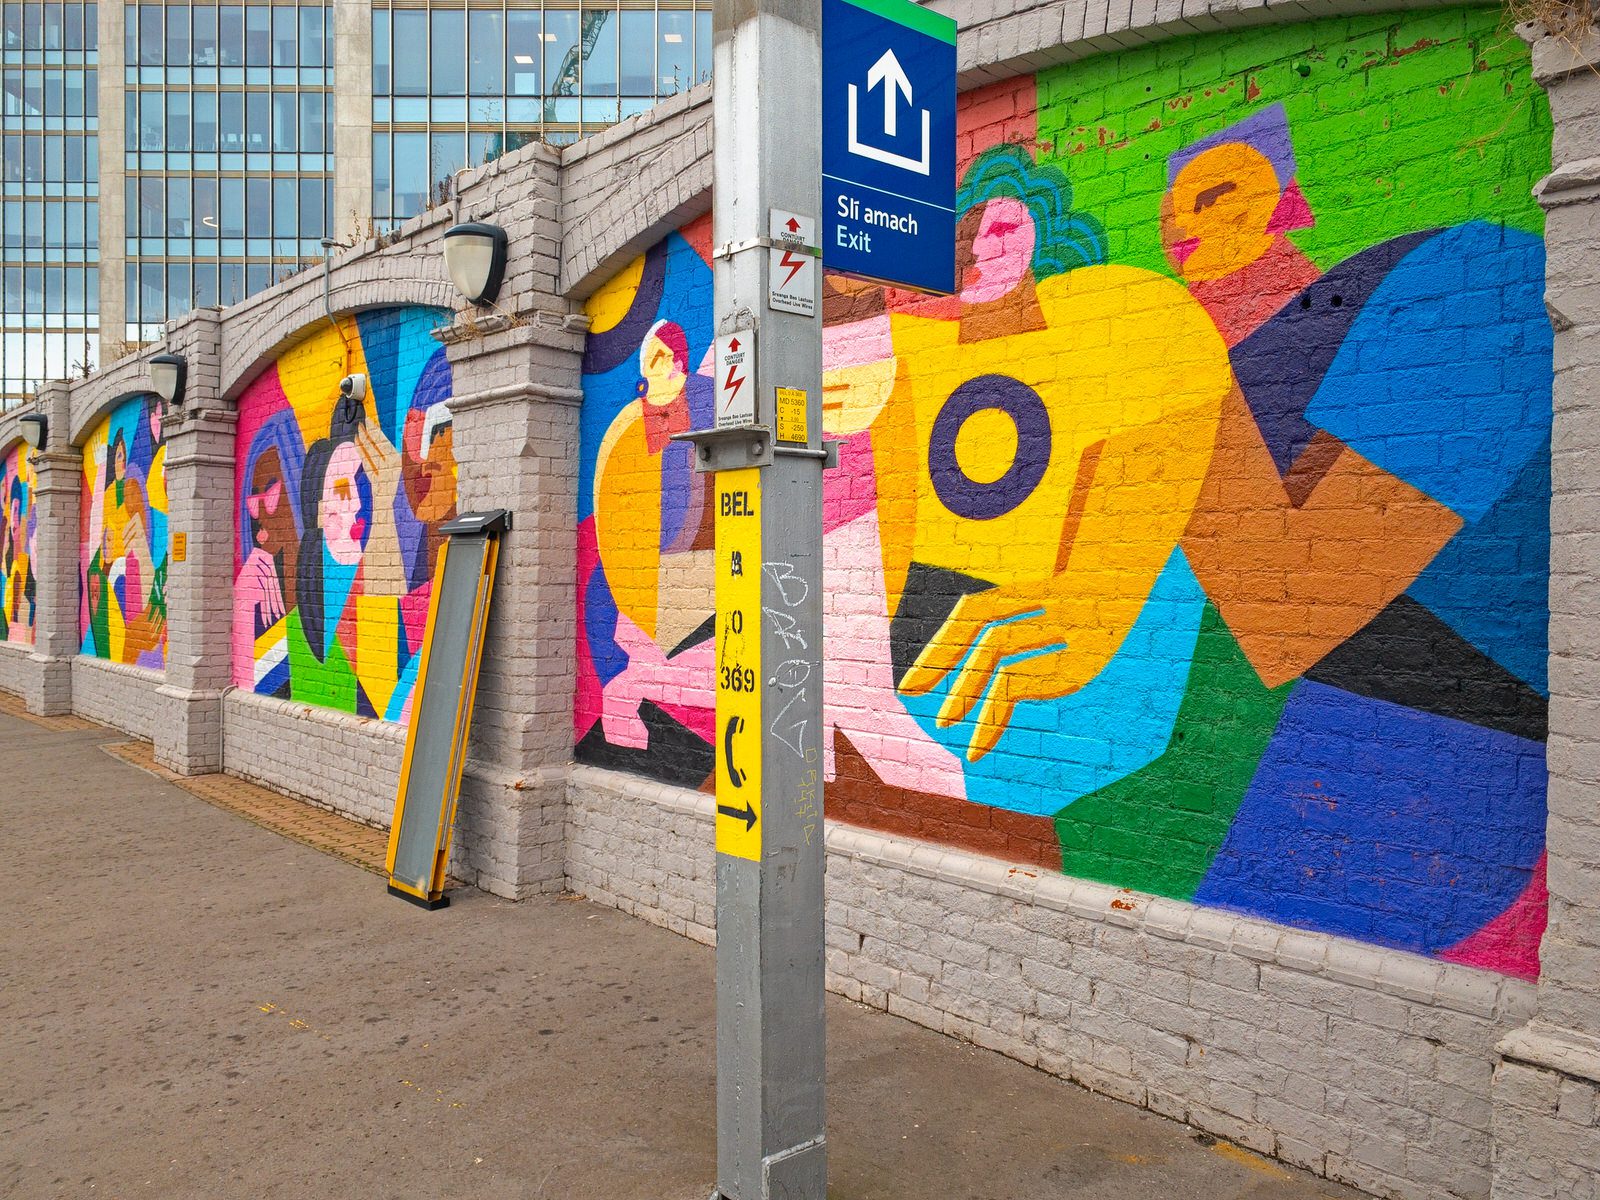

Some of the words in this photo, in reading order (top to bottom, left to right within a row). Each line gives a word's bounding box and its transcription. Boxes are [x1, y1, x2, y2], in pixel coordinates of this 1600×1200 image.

[837, 194, 860, 221] Slí
[864, 207, 918, 236] amach
[837, 224, 872, 253] Exit
[772, 297, 792, 306] Overhead
[792, 300, 801, 308] Live
[801, 302, 813, 310] Wires
[726, 358, 744, 366] DANGER
[780, 397, 790, 405] MD
[790, 398, 805, 407] 5360
[780, 432, 785, 440] H
[721, 491, 754, 517] BEL
[720, 666, 755, 693] 369
